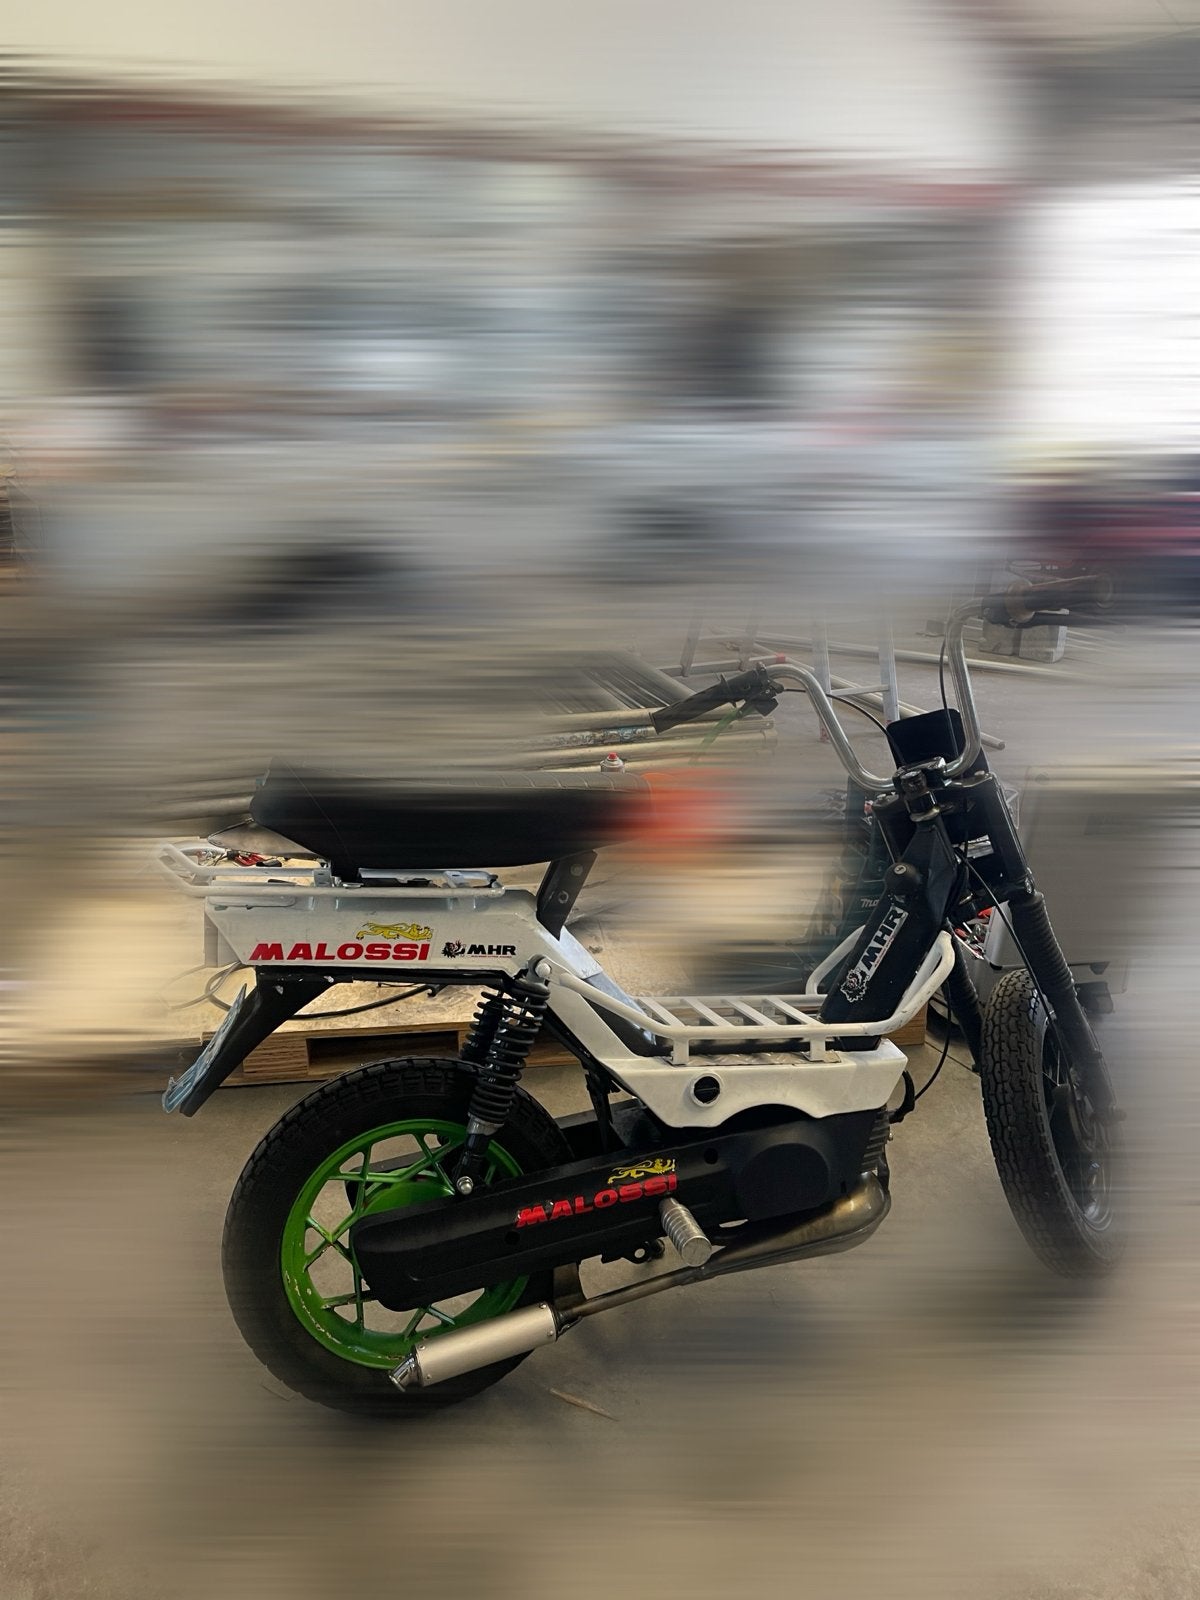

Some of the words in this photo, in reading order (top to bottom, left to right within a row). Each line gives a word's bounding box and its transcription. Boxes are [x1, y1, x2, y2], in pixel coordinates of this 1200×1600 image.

[249, 943, 430, 961] MALOSSI
[467, 944, 516, 955] MHR
[861, 908, 904, 970] MHR
[515, 1174, 678, 1228] MALOSSI
